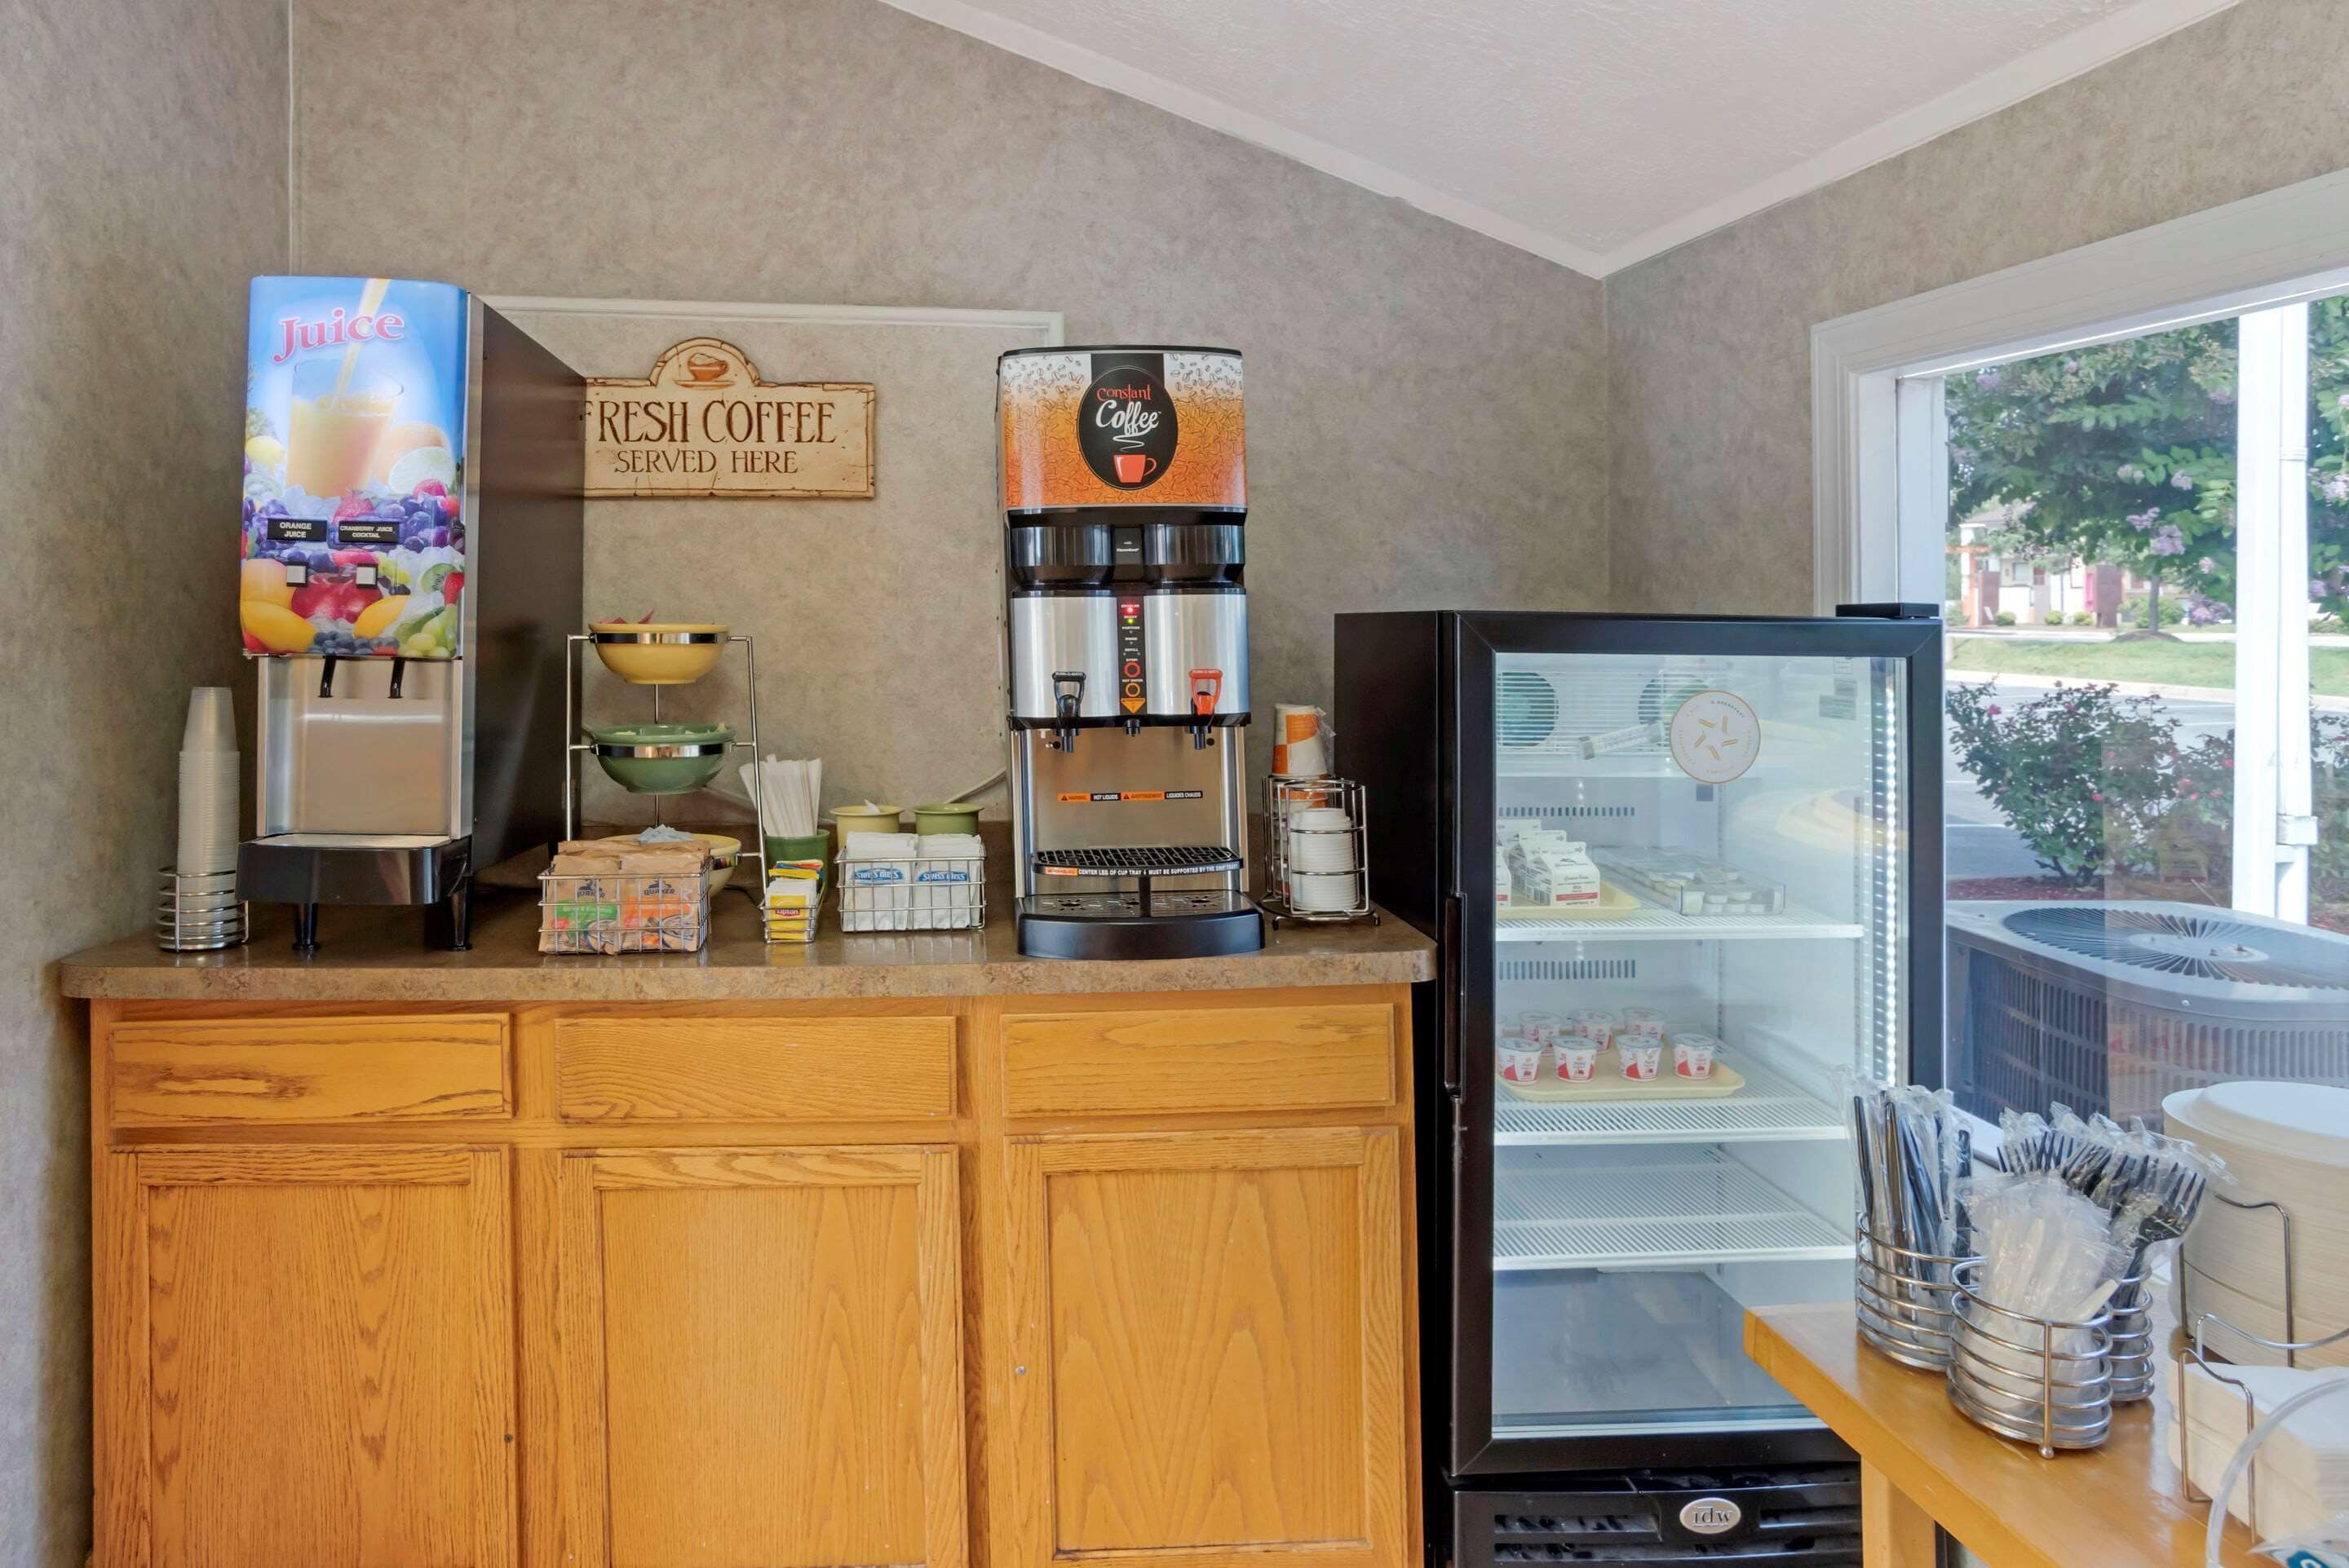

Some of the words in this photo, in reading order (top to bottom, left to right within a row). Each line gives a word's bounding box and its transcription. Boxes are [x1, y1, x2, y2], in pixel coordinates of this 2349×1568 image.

[272, 307, 405, 364] Juice
[1096, 384, 1152, 402] Constant
[702, 400, 837, 444] COFFEE
[614, 448, 718, 474] SERVED
[731, 450, 798, 474] HERE
[279, 522, 312, 530] ORANGE
[1170, 867, 1199, 875] SUPPORTED
